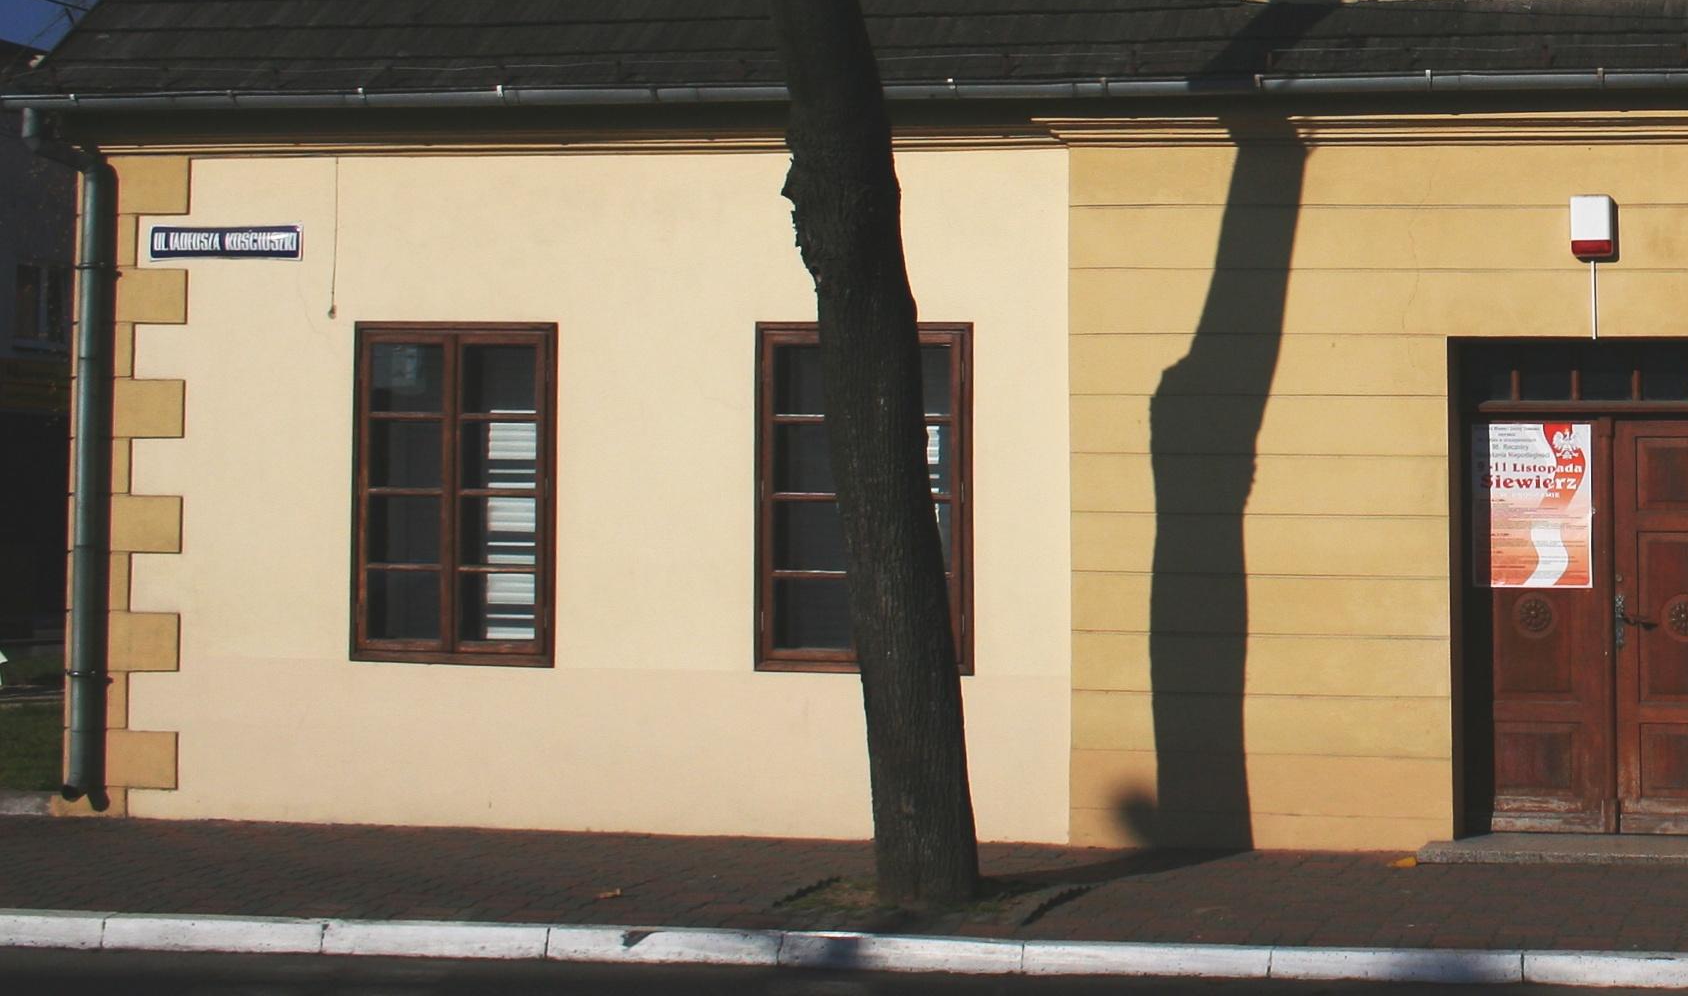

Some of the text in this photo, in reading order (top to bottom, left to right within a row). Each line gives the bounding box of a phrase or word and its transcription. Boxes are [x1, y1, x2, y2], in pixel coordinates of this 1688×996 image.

[169, 232, 220, 251] TADEUSZA
[1512, 462, 1583, 474] Listopada
[1480, 474, 1577, 490] Siewierz
